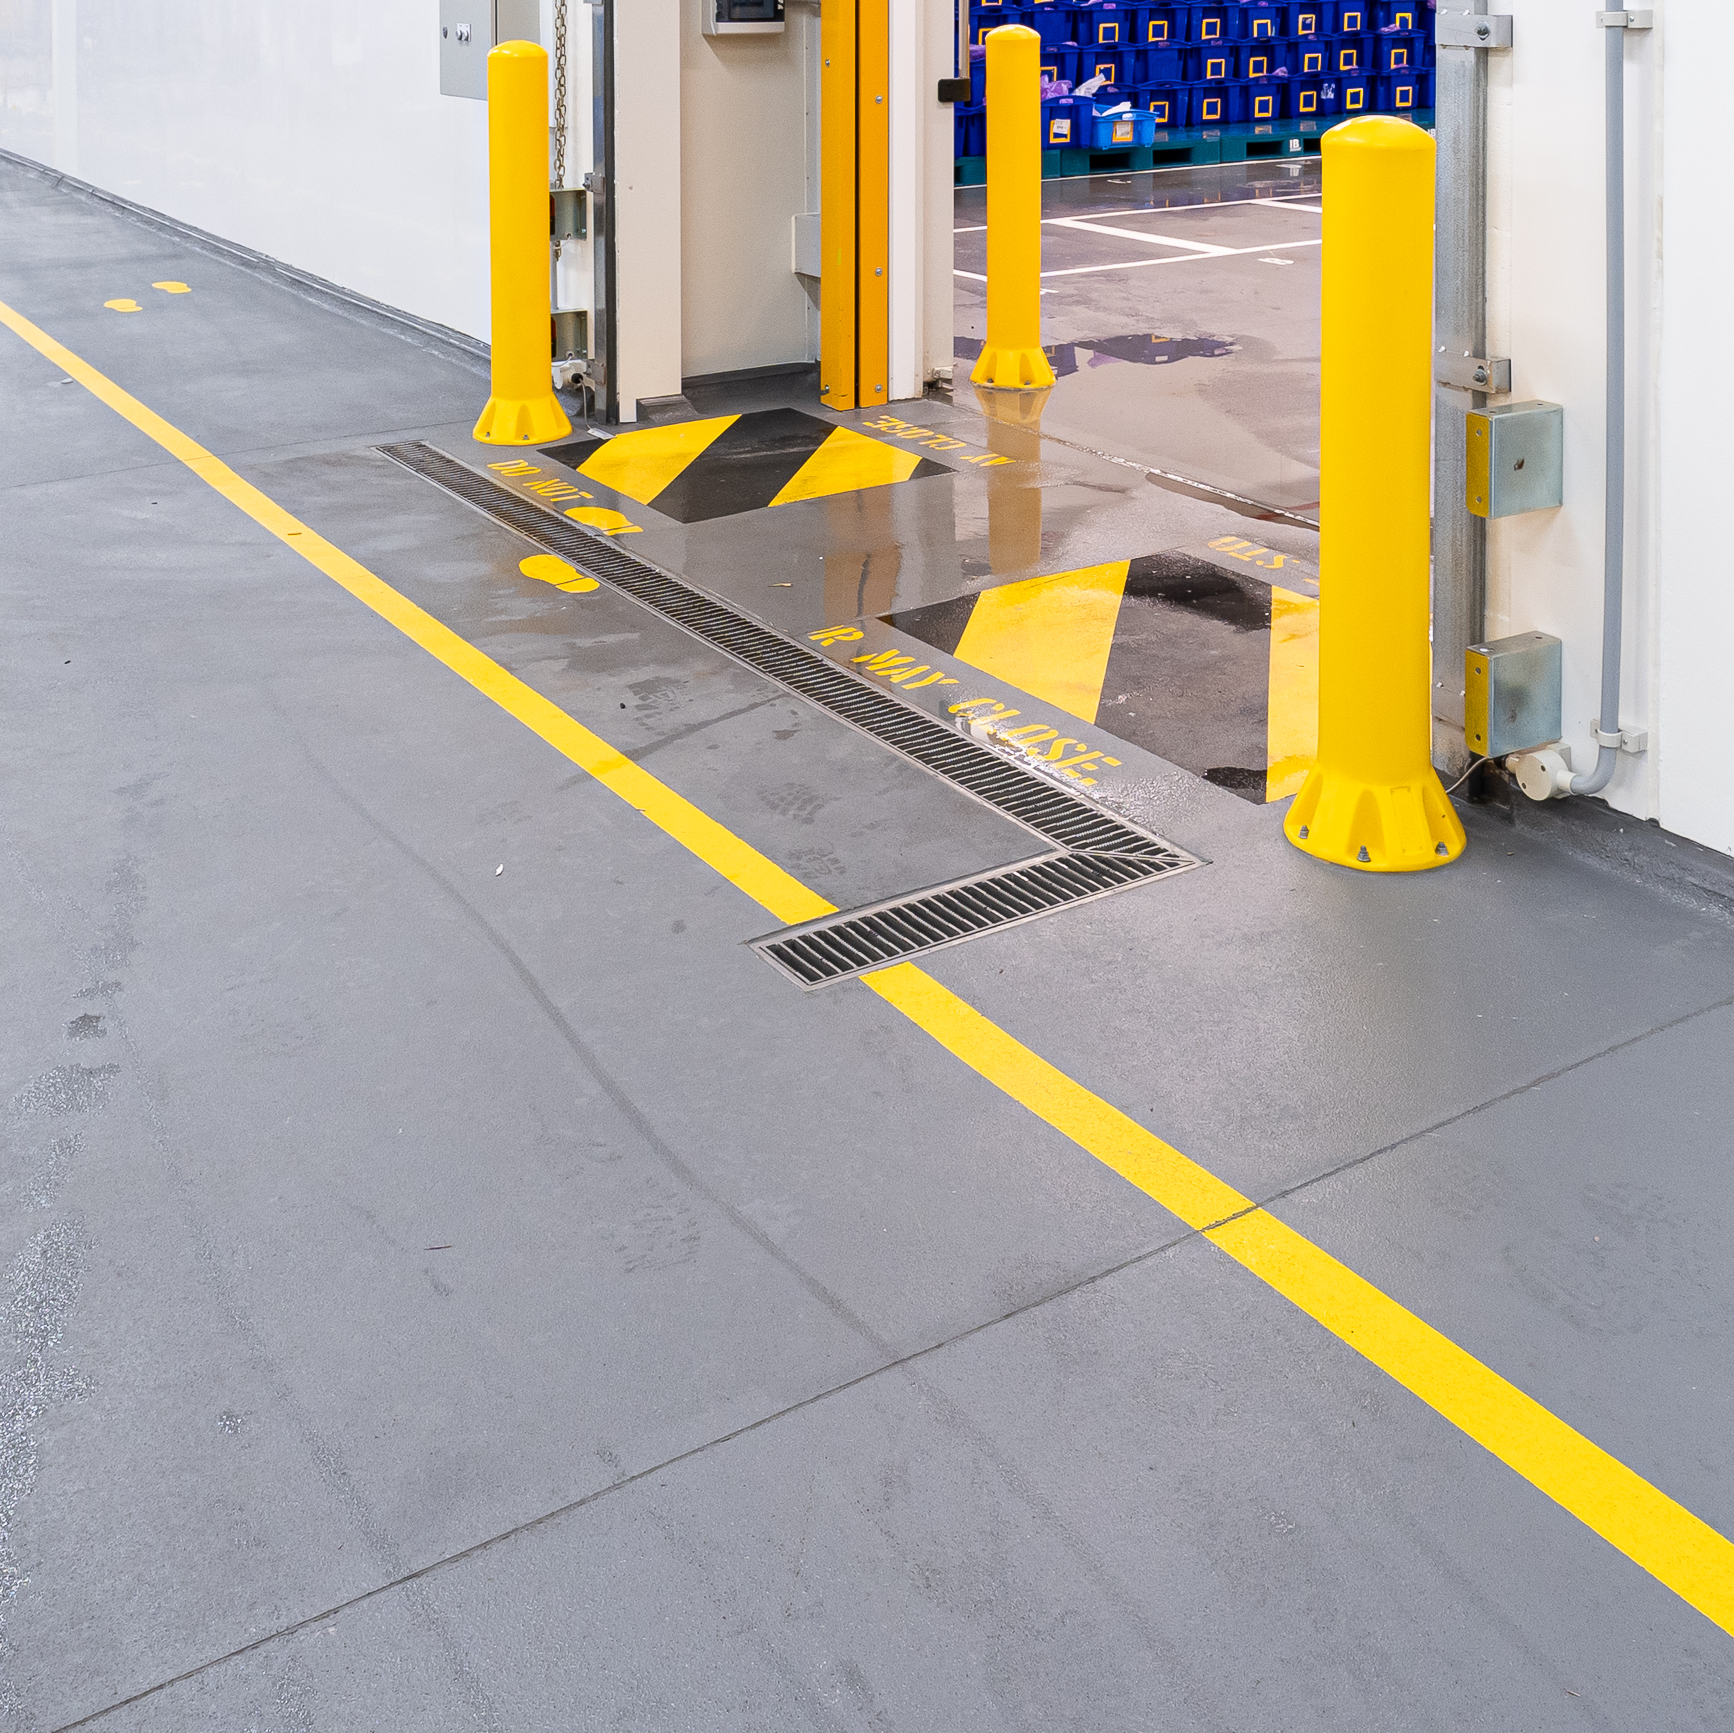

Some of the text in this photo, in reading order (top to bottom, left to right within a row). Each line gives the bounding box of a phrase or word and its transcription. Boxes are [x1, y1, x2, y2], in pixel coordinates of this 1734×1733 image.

[862, 415, 967, 450] CLOSE
[487, 459, 594, 502] DO NOT
[851, 649, 959, 690] MAY
[948, 697, 1122, 787] CLOSE
